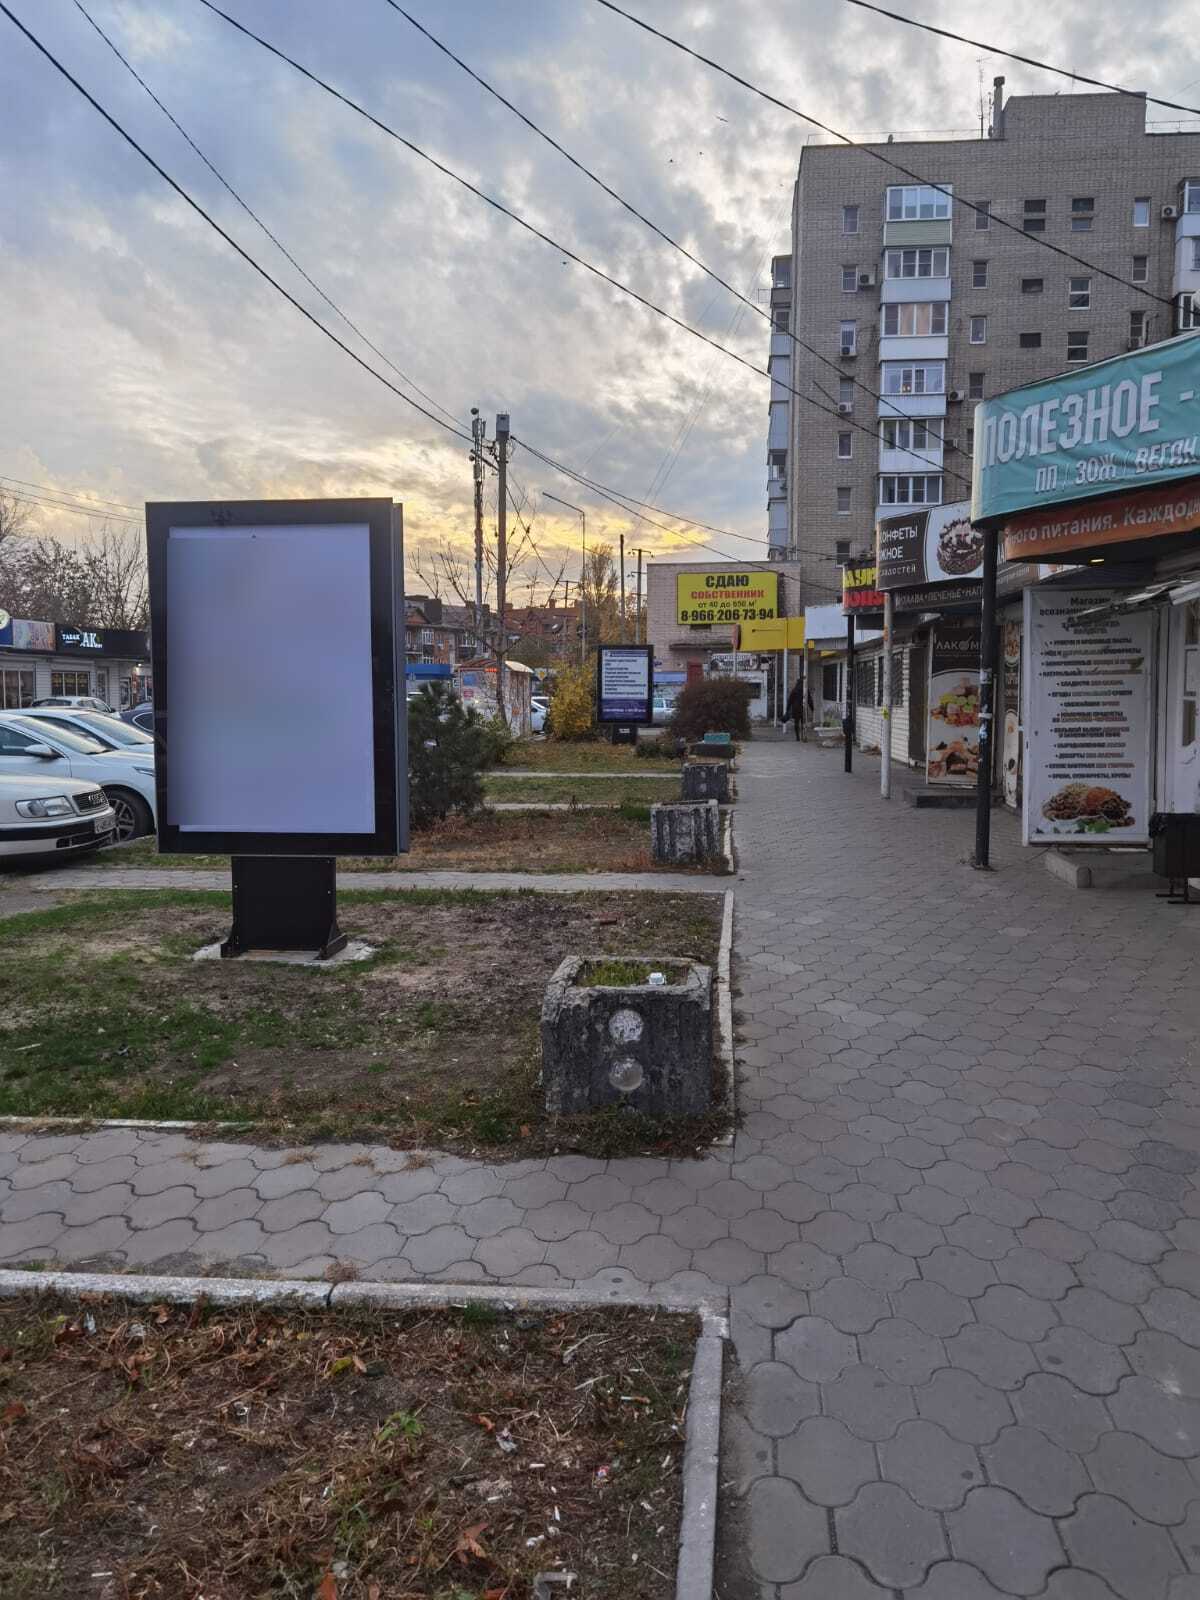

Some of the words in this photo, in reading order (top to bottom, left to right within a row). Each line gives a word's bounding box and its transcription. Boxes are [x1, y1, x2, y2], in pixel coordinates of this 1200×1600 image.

[983, 371, 1162, 467] ПОЛЕЗНОЕ
[1074, 453, 1117, 484] ЗОЖ
[1041, 514, 1118, 541] питания.
[691, 590, 765, 600] СОБСТВЕННИК
[705, 574, 749, 589] СДАЮ
